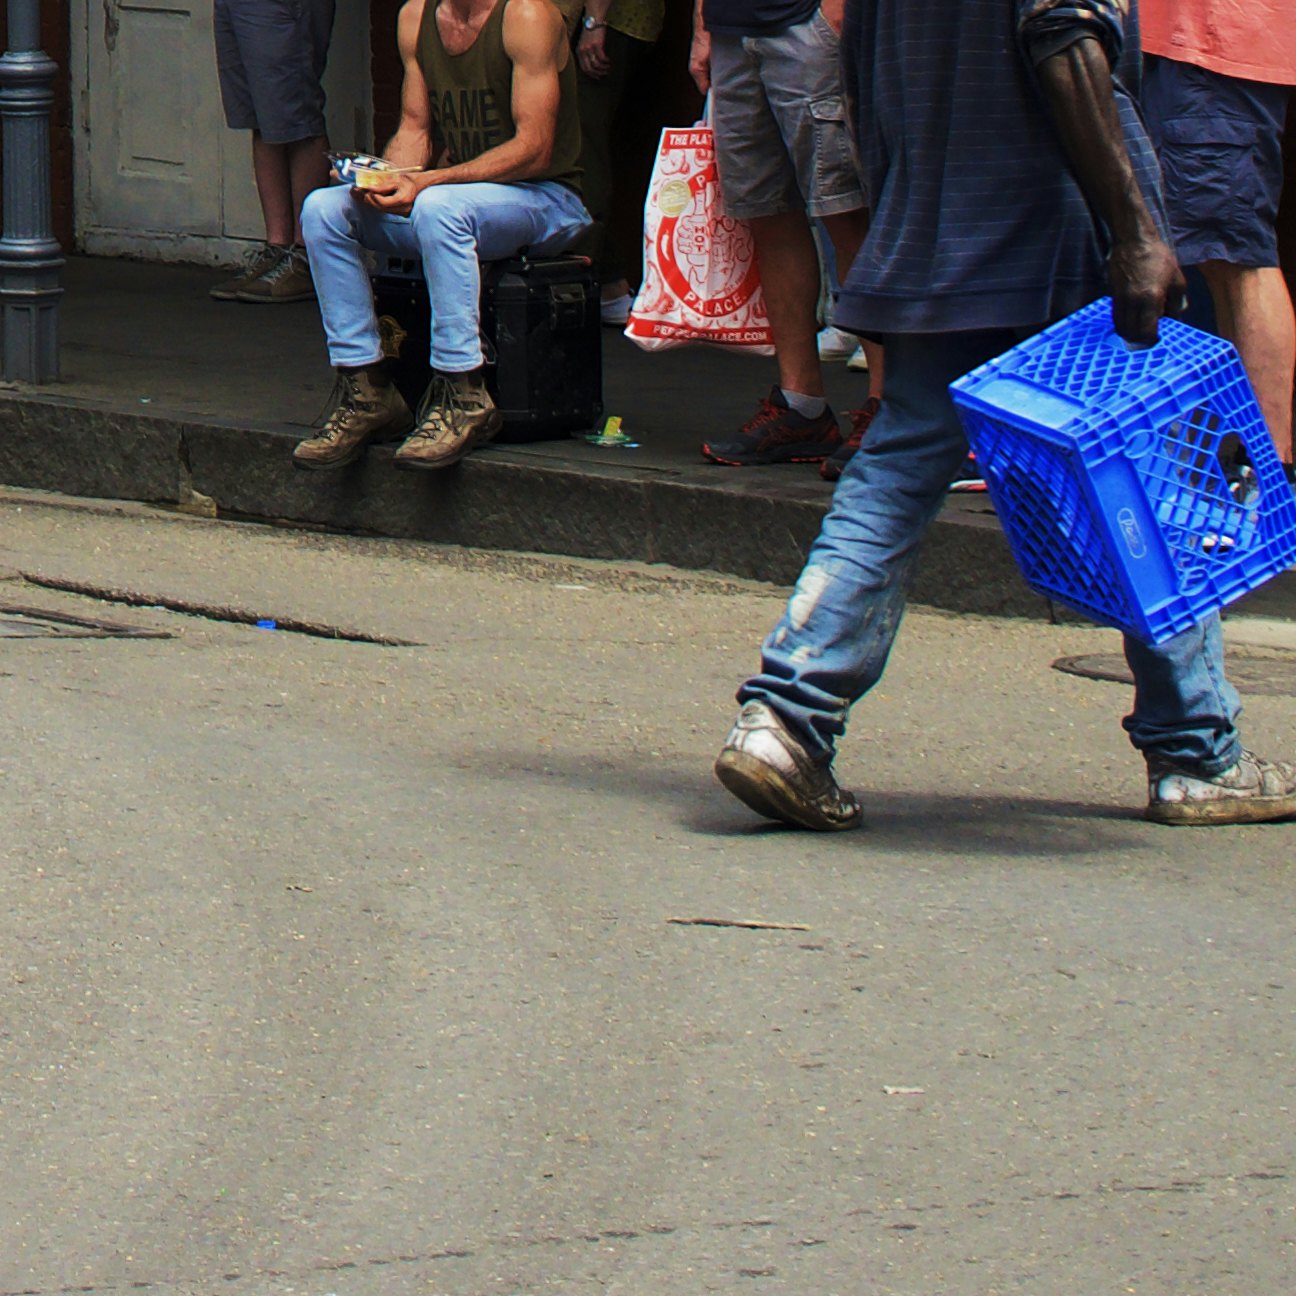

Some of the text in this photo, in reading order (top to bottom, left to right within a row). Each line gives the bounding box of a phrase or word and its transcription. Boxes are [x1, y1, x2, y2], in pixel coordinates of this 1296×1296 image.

[429, 89, 501, 127] SAME
[669, 134, 688, 146] THE
[694, 226, 705, 252] HOT
